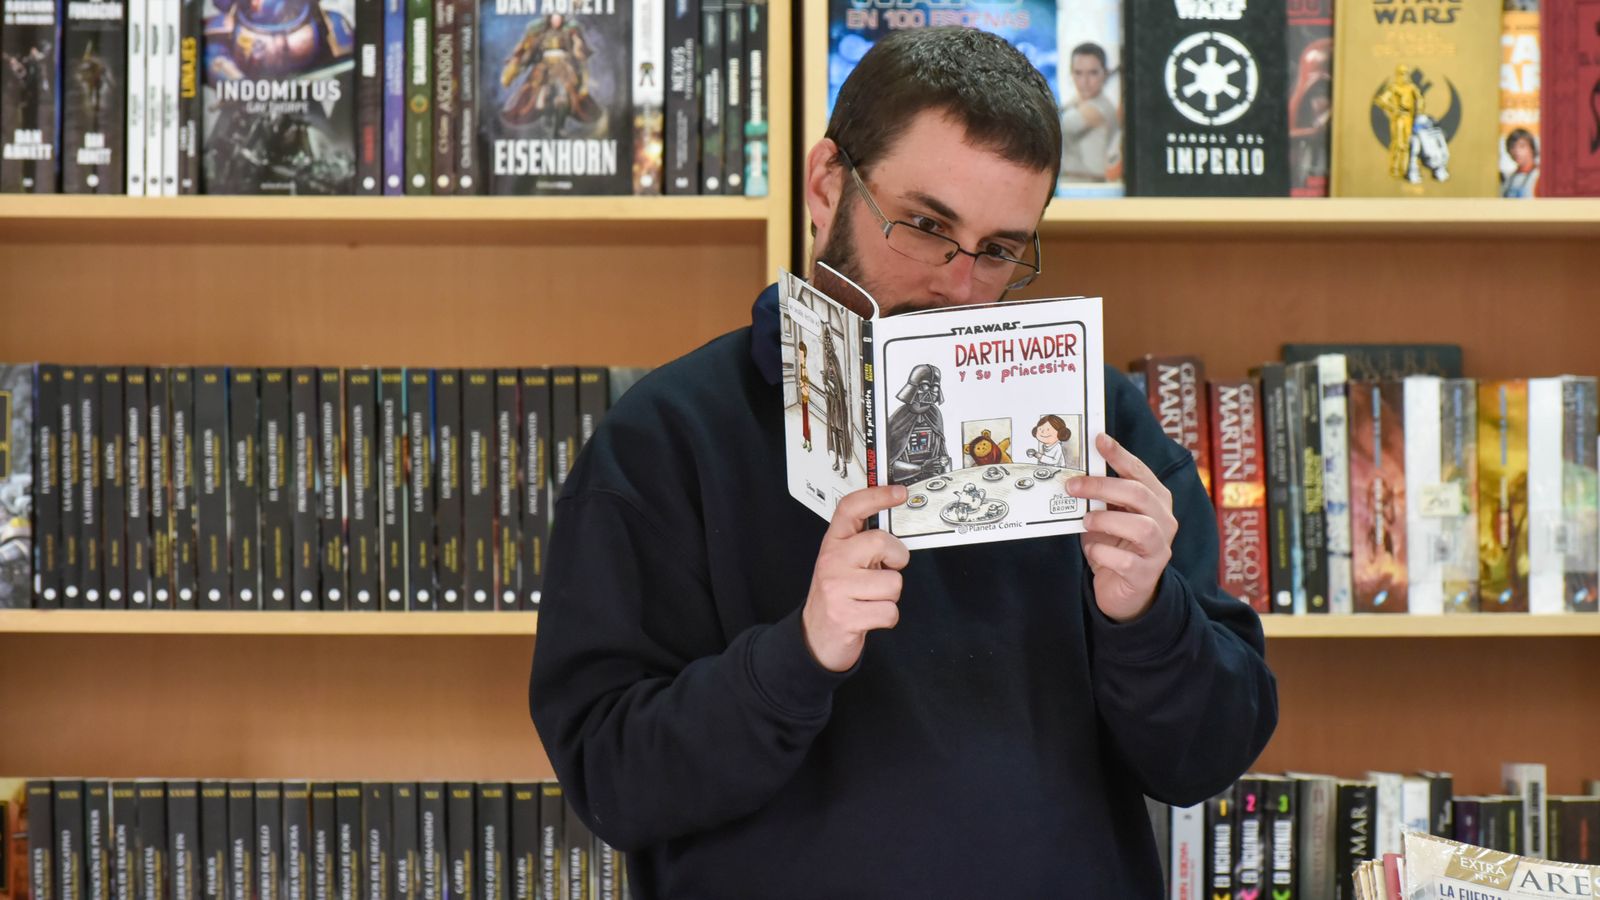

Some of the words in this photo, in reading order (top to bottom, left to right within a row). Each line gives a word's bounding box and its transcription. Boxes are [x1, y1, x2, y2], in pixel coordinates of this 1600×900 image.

[846, 9, 878, 29] EN
[883, 9, 926, 29] 100
[1373, 8, 1462, 24] WARS
[216, 79, 341, 101] INDOMITUS
[494, 139, 617, 175] EISENHORN
[1166, 147, 1265, 175] IMPERIO
[955, 338, 1013, 368] DARTH
[1018, 333, 1077, 361] VADER
[958, 370, 967, 382] y
[976, 369, 991, 380] su
[1001, 360, 1077, 383] princesita
[865, 389, 875, 427] princesita
[1157, 365, 1183, 446] MART
[1180, 363, 1198, 428] GEORGE
[1240, 384, 1257, 439] GEORGE
[1219, 386, 1243, 480] MARTIN
[969, 524, 996, 532] Planeta
[1223, 511, 1244, 584] SANGRE
[1241, 511, 1261, 579] FUEGO
[1245, 794, 1257, 812] 2
[1278, 795, 1289, 813] 3
[1460, 857, 1507, 877] EXTRA
[1440, 883, 1455, 898] LA
